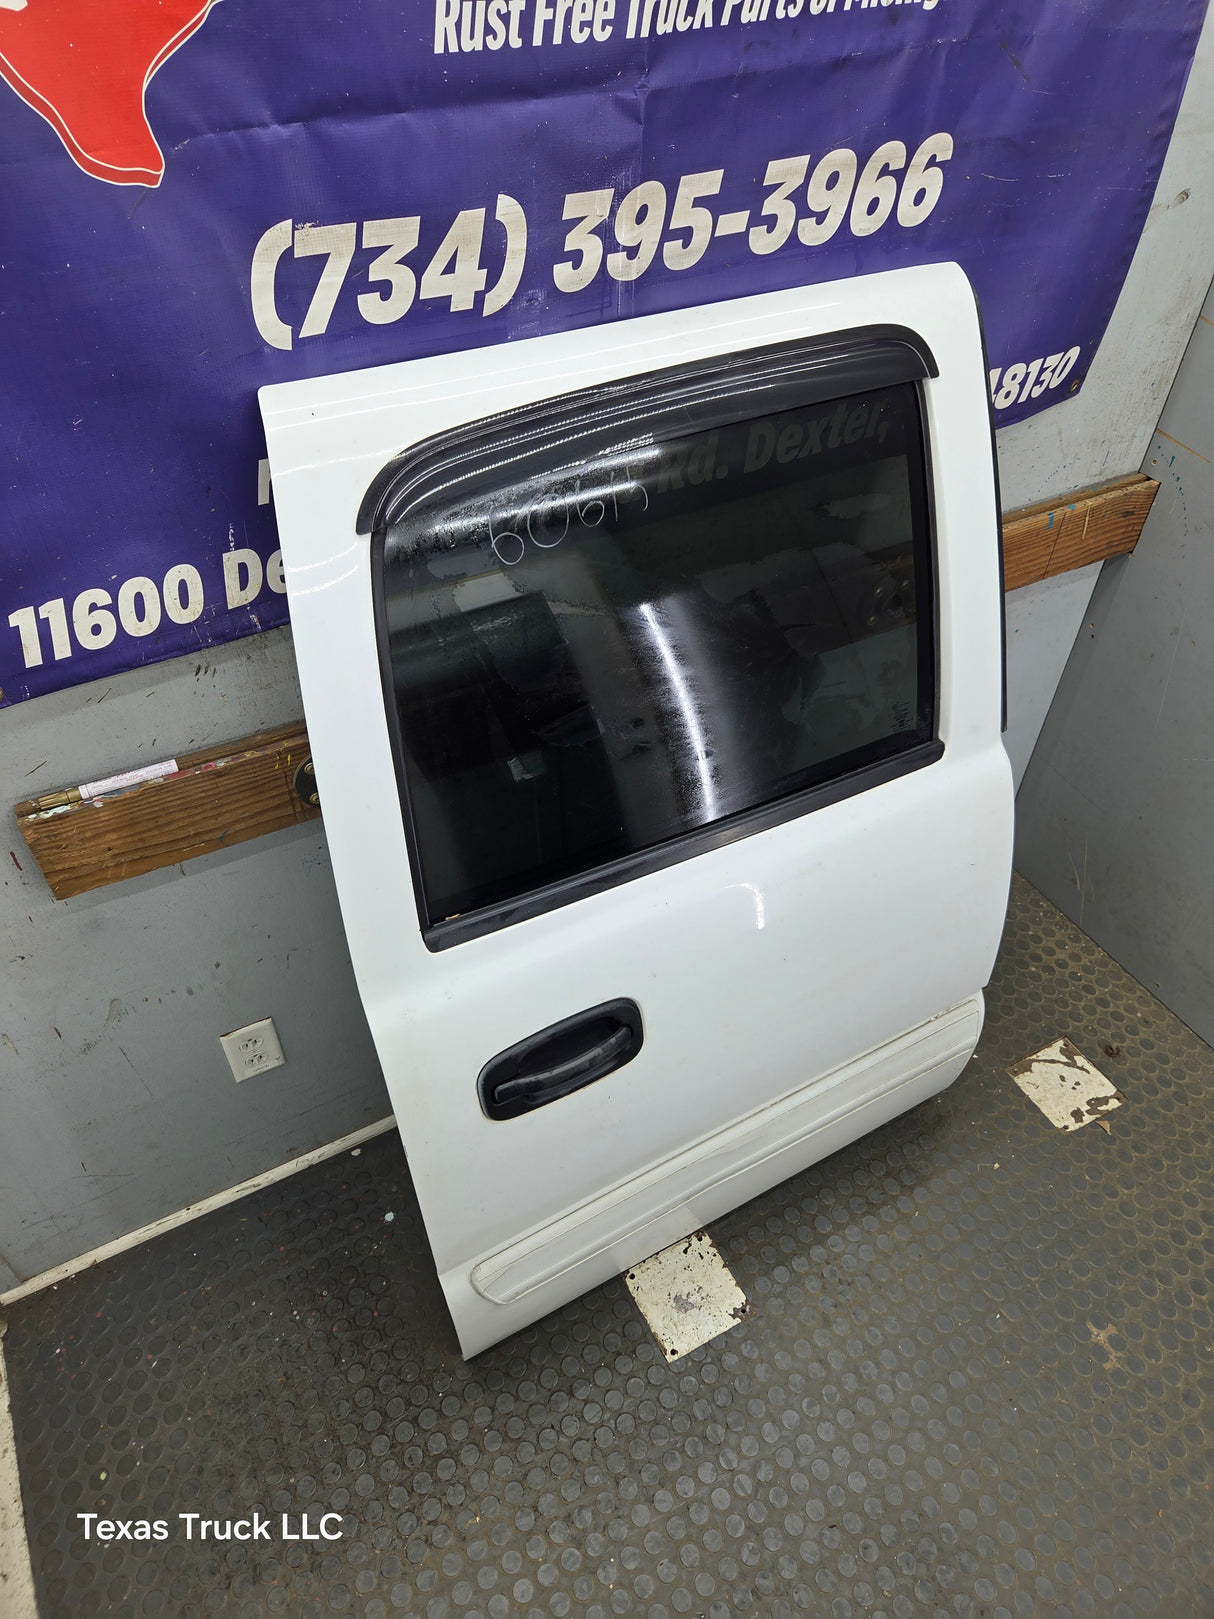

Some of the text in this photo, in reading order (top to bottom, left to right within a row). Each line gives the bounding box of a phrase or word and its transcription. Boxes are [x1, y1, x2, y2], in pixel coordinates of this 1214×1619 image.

[434, 0, 525, 54] Rust
[532, 0, 615, 46] Free
[250, 132, 954, 350] (734) 395-3966
[8, 563, 204, 669] 11600
[656, 432, 729, 494] Rd.
